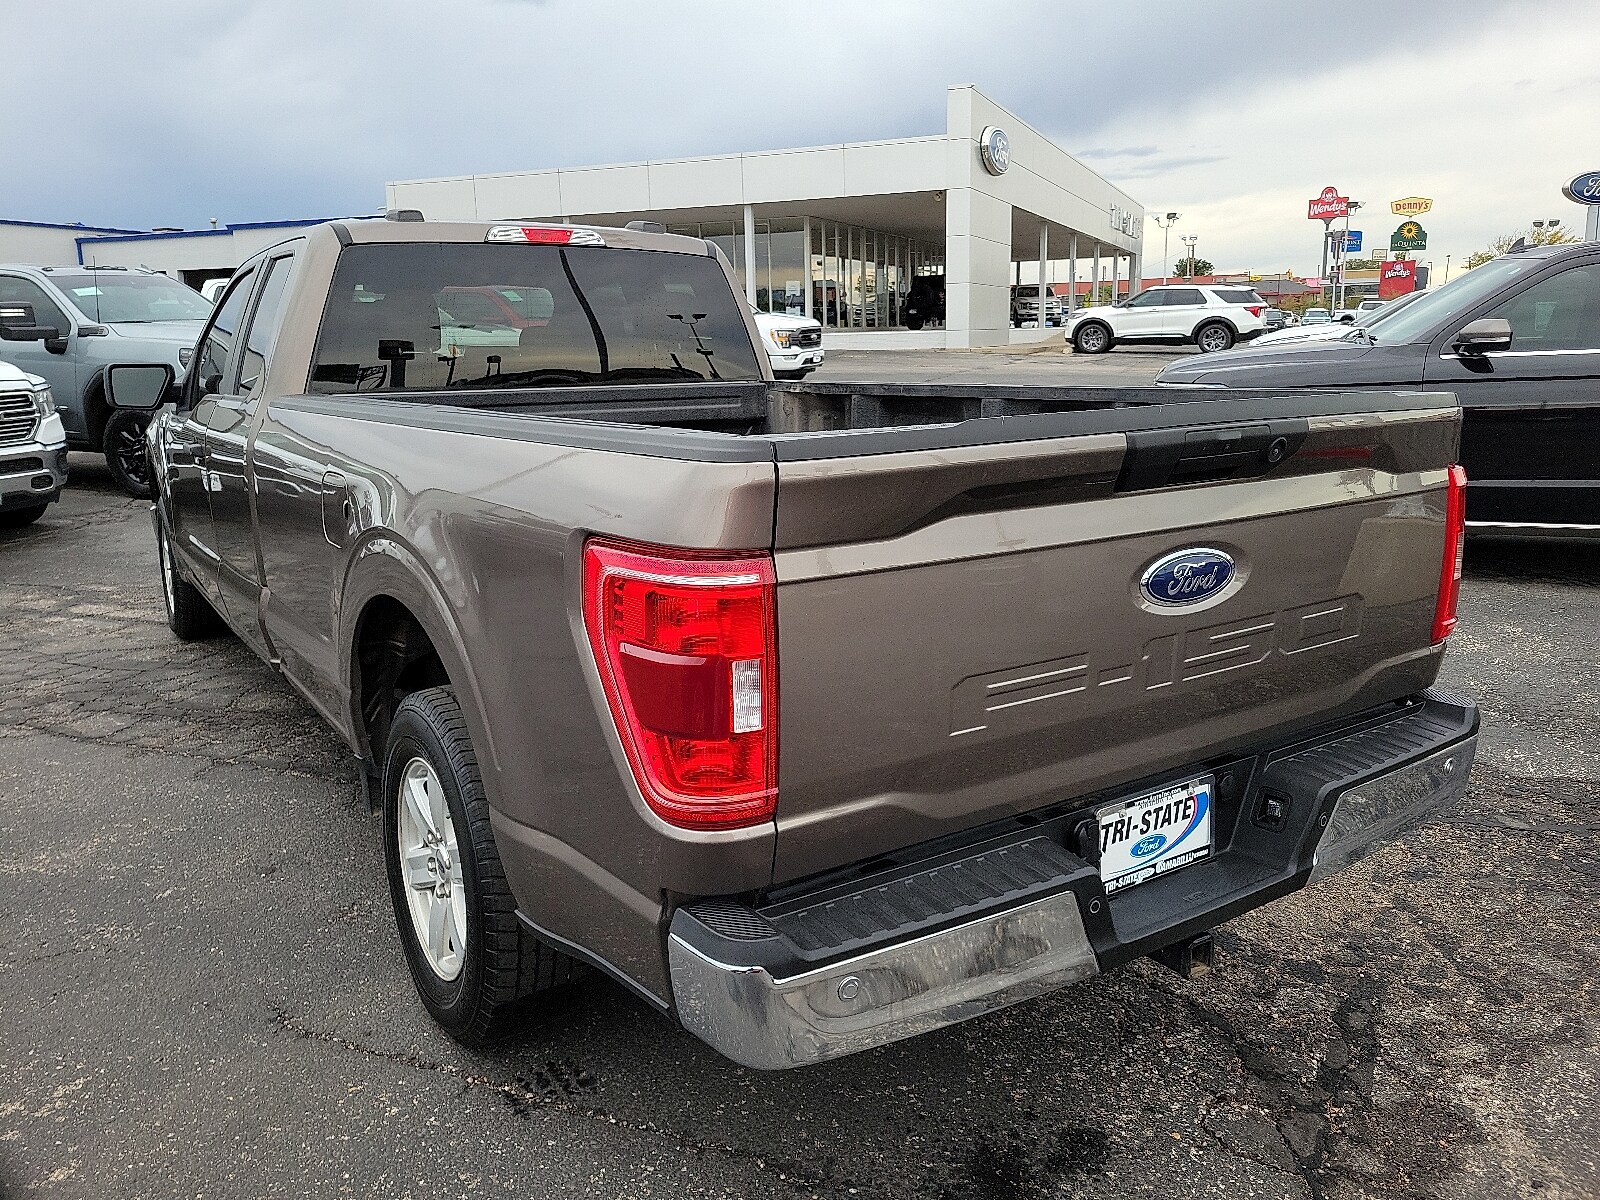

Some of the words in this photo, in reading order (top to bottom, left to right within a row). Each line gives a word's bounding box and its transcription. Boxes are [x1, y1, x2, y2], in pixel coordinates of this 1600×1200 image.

[1310, 200, 1347, 216] Wendy's
[1395, 201, 1430, 212] Denny's
[1397, 240, 1426, 248] QUINTA
[1385, 268, 1411, 279] Wendy's
[1167, 562, 1219, 597] Ford
[950, 592, 1364, 737] F-150
[1101, 797, 1194, 854] TRI-STATE
[1137, 838, 1161, 855] Ford
